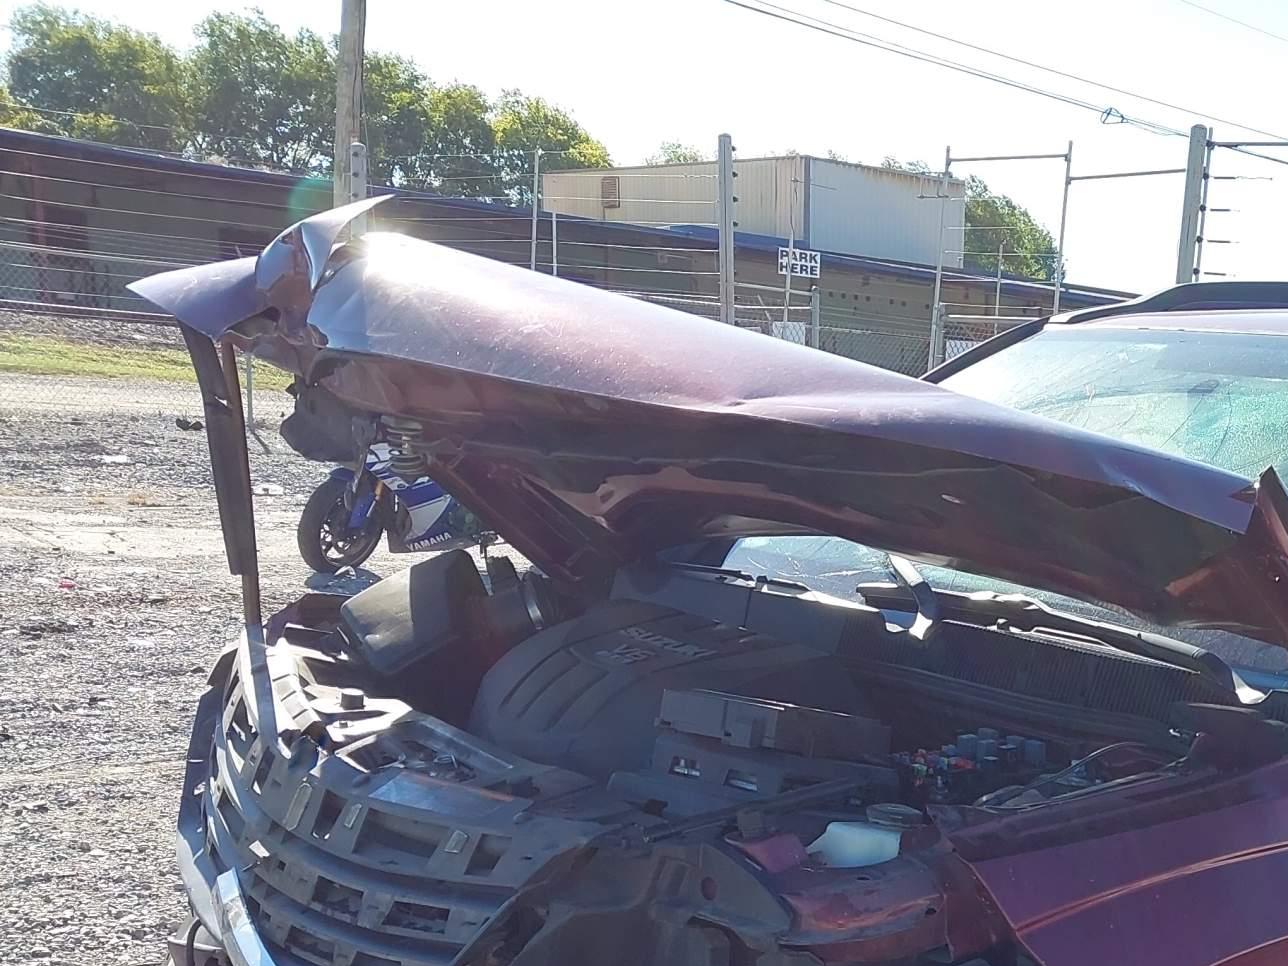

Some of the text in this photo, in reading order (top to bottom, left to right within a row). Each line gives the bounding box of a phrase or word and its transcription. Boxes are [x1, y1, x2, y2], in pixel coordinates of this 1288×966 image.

[779, 249, 819, 265] PARK
[779, 261, 819, 277] HERE
[405, 531, 452, 552] YAMAHA
[619, 626, 719, 657] SUZUKI
